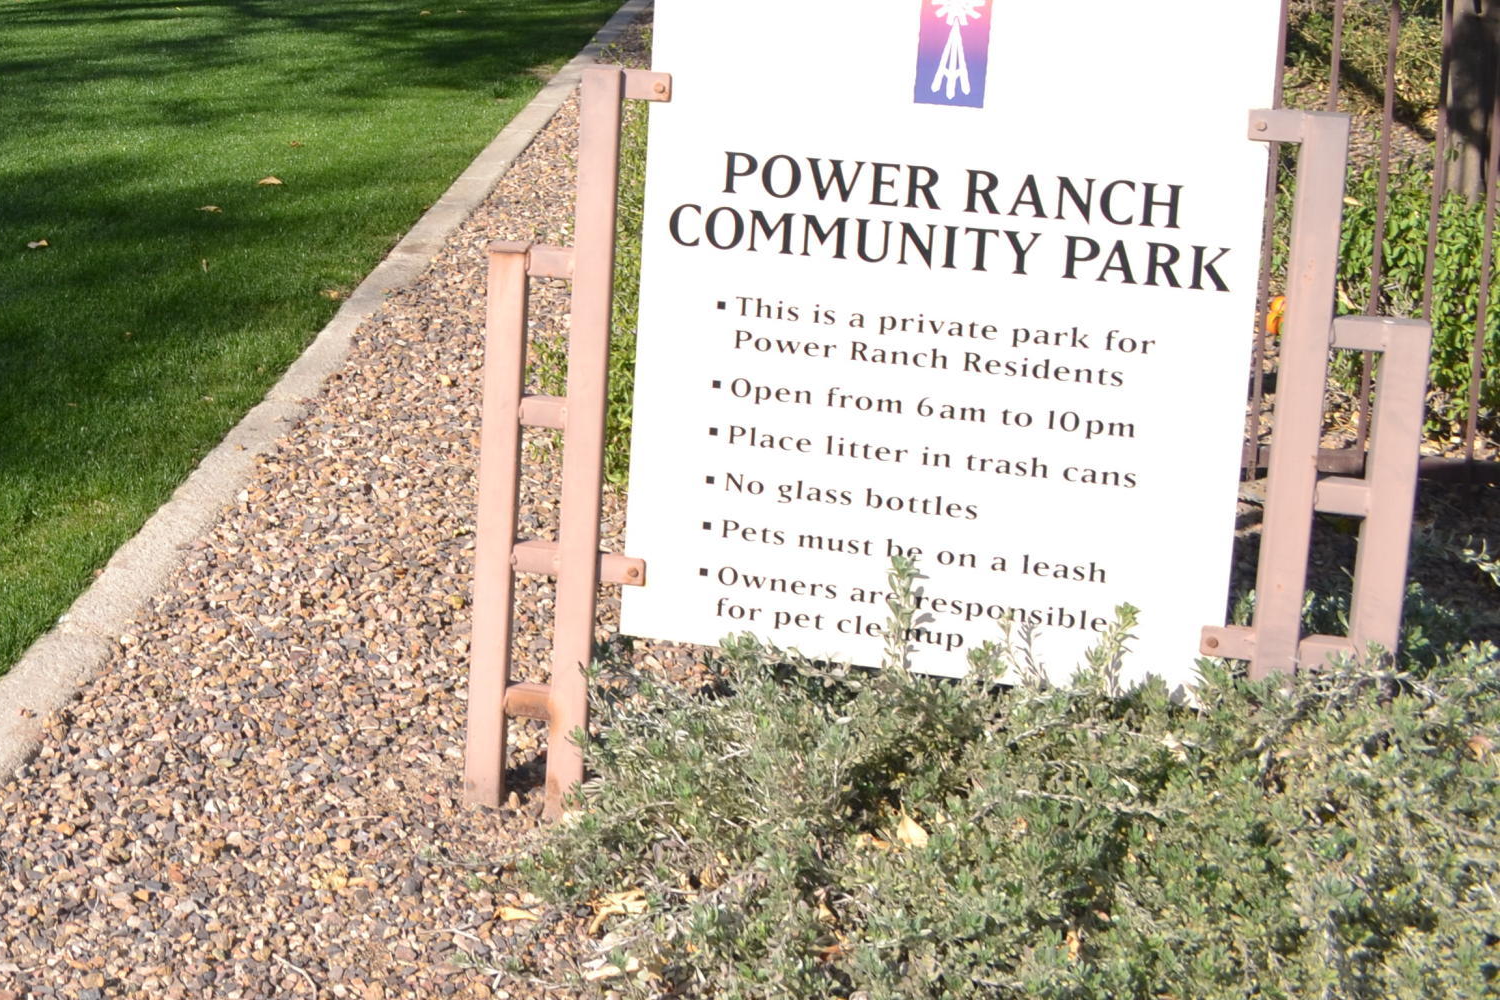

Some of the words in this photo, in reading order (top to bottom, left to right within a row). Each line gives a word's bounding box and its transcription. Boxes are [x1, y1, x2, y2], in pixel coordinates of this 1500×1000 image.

[722, 151, 941, 210] POWER
[963, 169, 1184, 229] RANCH
[669, 203, 1042, 276] COMMUNITY
[1061, 235, 1231, 293] PARK
[735, 296, 799, 321] This
[813, 304, 836, 325] is
[848, 313, 864, 329] a
[879, 313, 998, 340] private
[1012, 326, 1089, 349] park
[1106, 329, 1156, 354] for
[735, 329, 837, 358] Power
[851, 341, 948, 370] Ranch
[963, 351, 1123, 387] Residents
[730, 378, 811, 405] Open
[827, 386, 902, 414] from
[917, 397, 986, 423] 6am
[1002, 409, 1033, 427] to
[1048, 410, 1135, 440] 10pm
[729, 425, 812, 453] Place
[826, 435, 908, 463] litter
[922, 446, 950, 468] in
[967, 454, 1048, 479] trash
[1062, 467, 1136, 488] cans
[725, 472, 765, 495] No
[778, 480, 852, 505] glass
[866, 487, 978, 519] bottles
[722, 519, 785, 545] Pets
[798, 534, 870, 556] must
[886, 538, 923, 562] be
[936, 551, 976, 568] on
[990, 557, 1006, 572] a
[1023, 554, 1106, 584] leash
[717, 567, 837, 599] Owners
[915, 595, 1107, 633] responsible
[717, 596, 762, 621] for
[774, 611, 822, 630] pet
[837, 615, 964, 652] clenup
